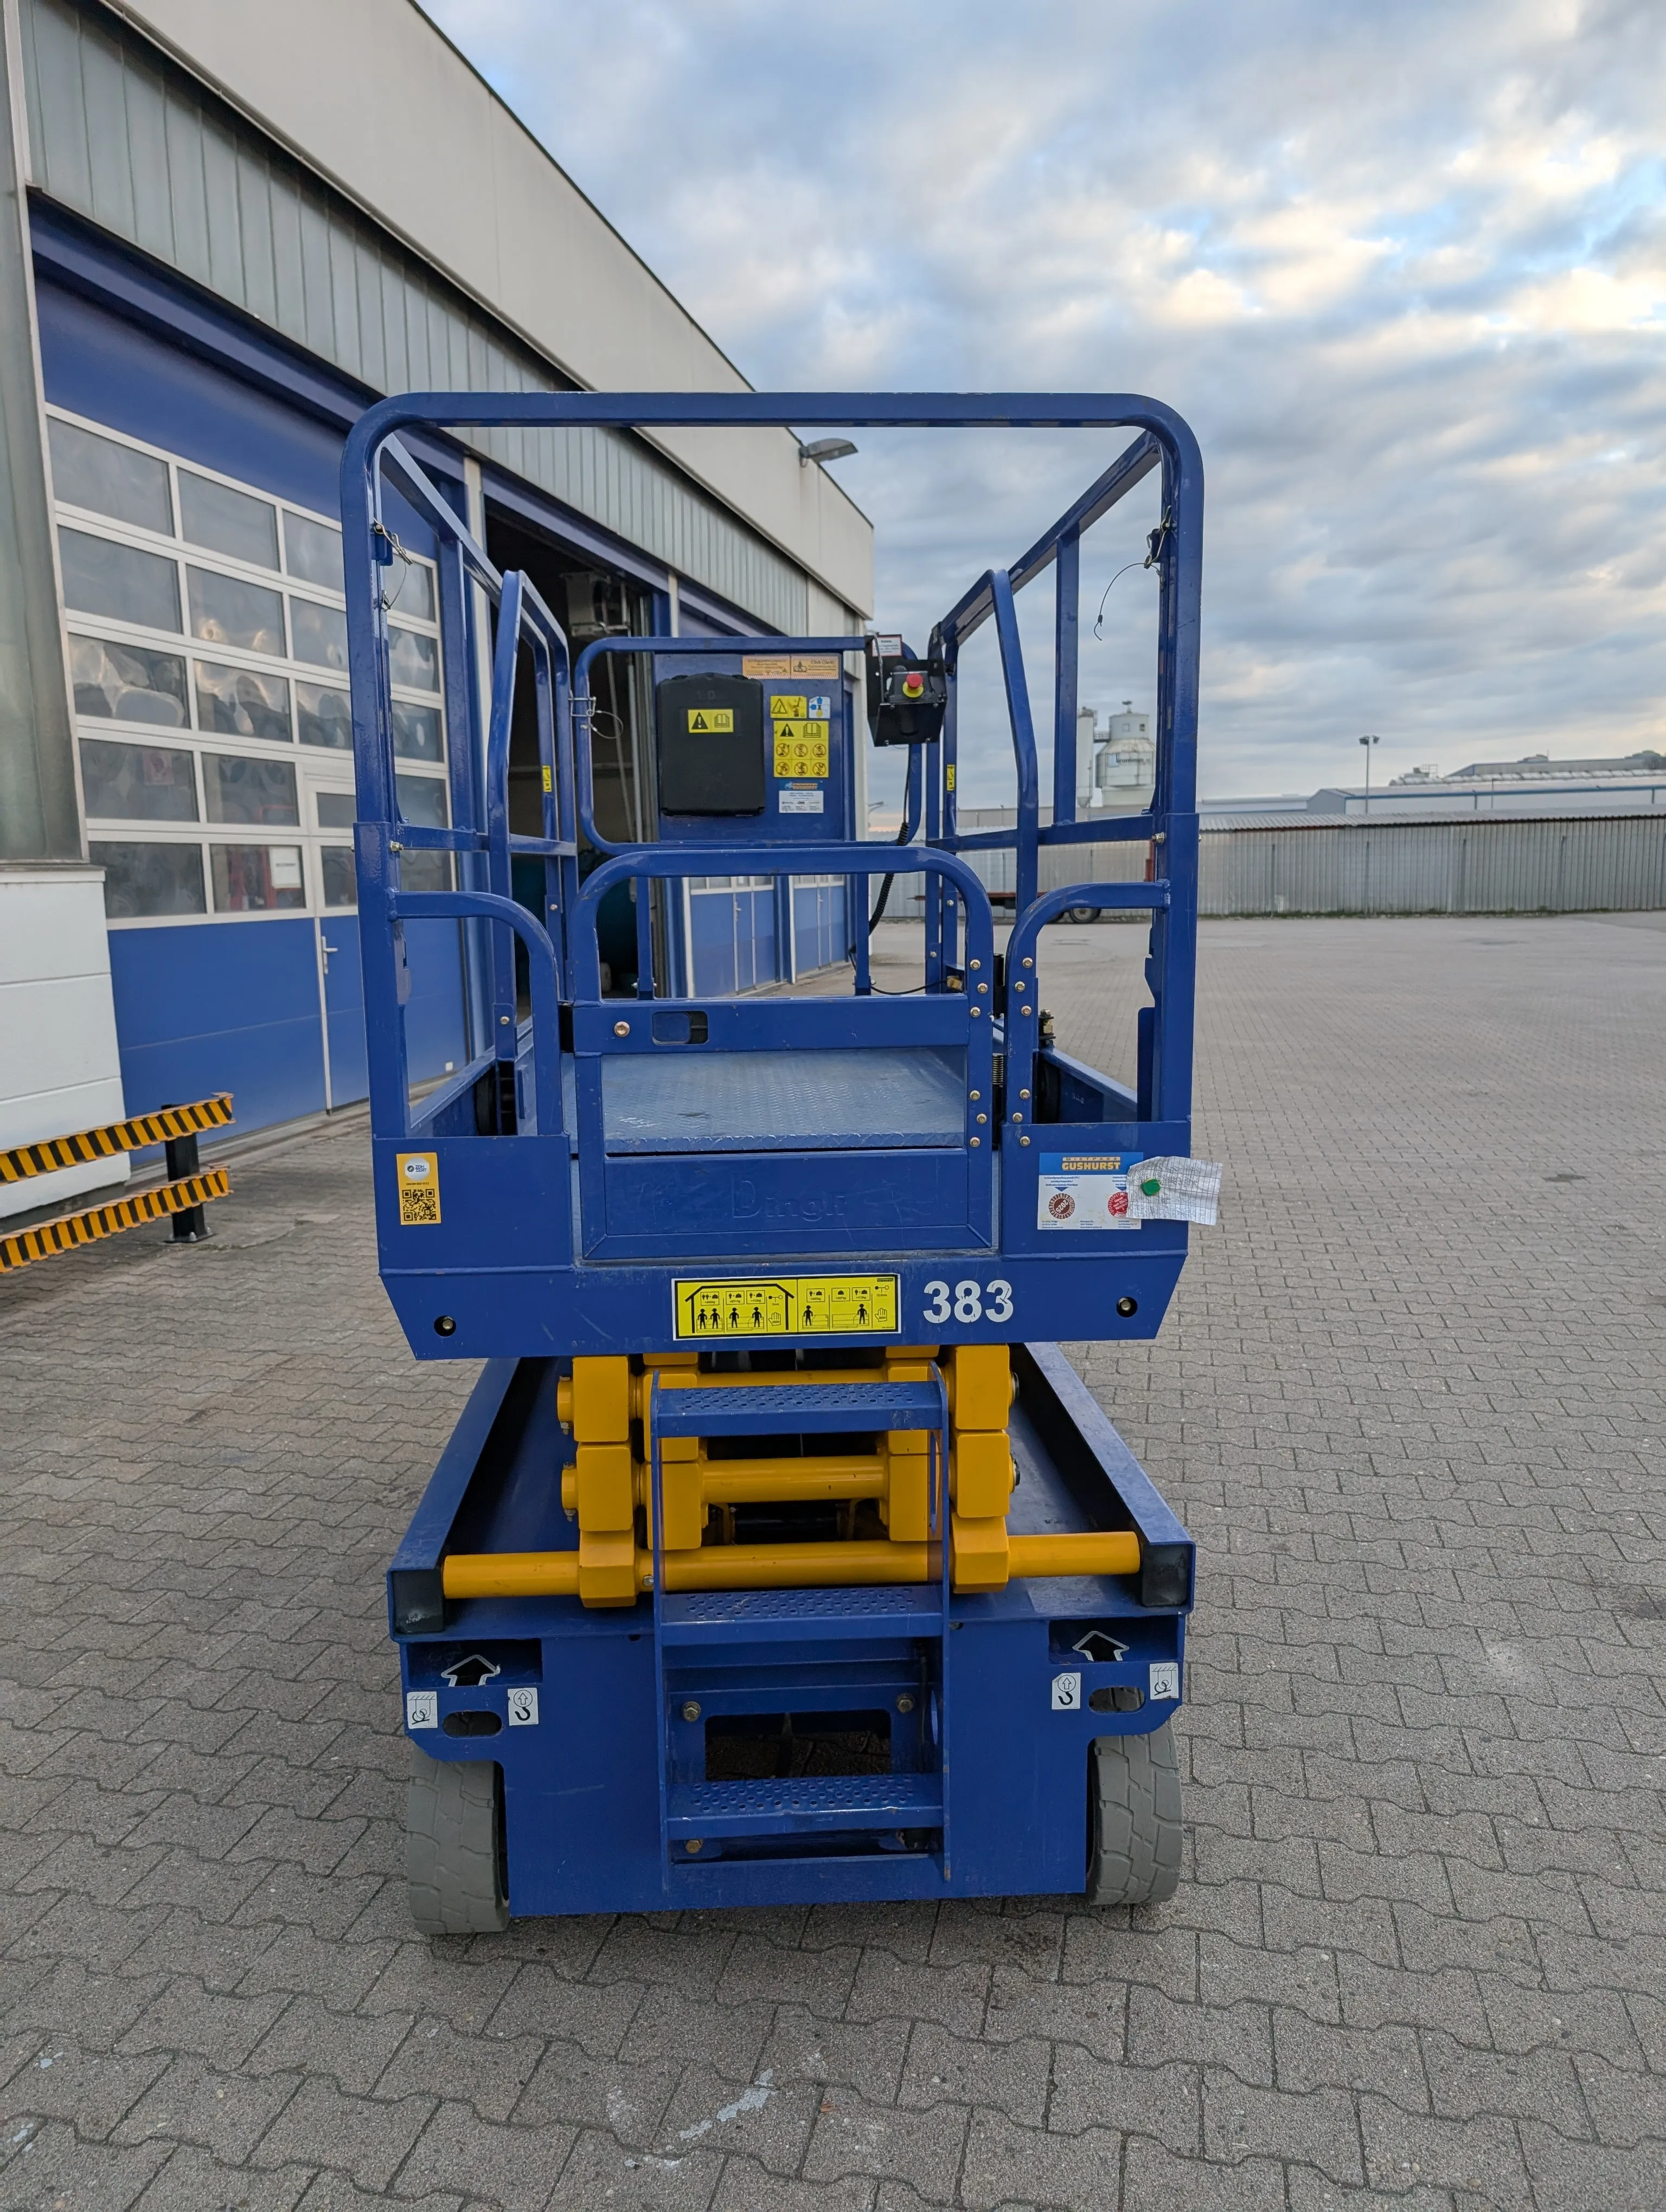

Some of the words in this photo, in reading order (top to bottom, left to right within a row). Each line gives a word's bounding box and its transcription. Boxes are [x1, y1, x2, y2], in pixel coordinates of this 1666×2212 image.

[1062, 1162, 1121, 1171] GUSHURST
[732, 1176, 845, 1221] Dingli
[1055, 1199, 1069, 1213] 2025
[922, 1279, 1015, 1324] 383
